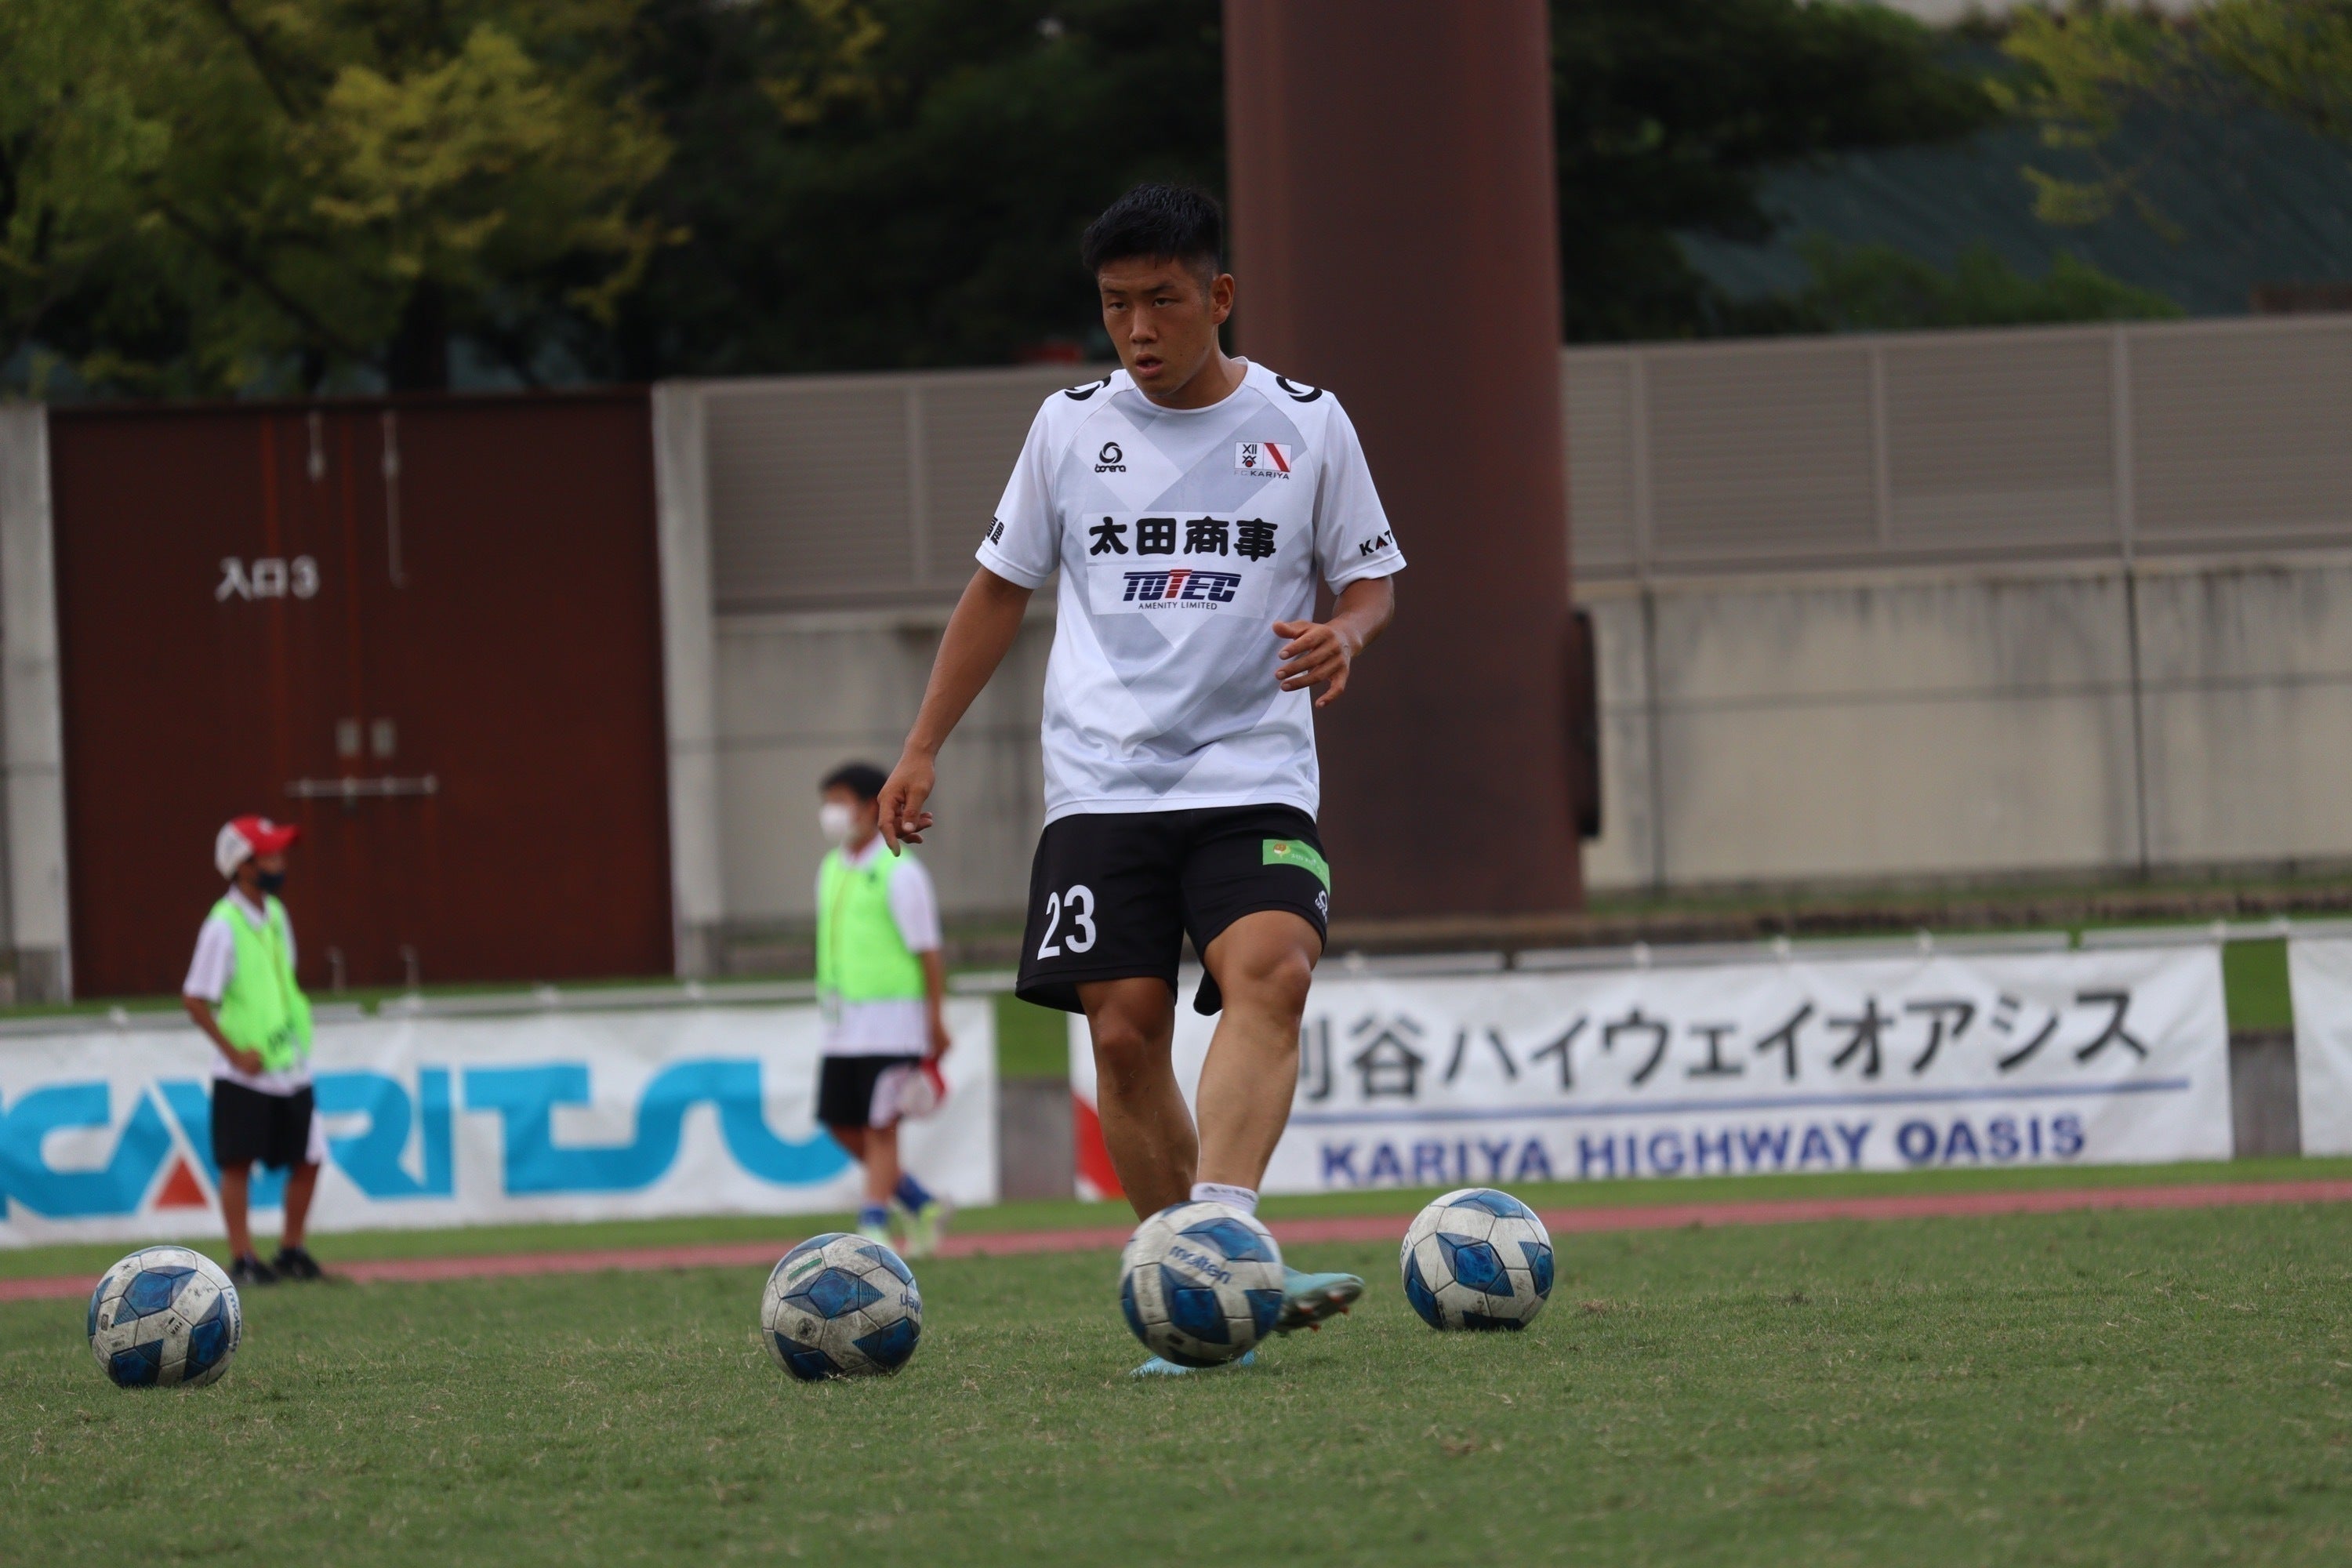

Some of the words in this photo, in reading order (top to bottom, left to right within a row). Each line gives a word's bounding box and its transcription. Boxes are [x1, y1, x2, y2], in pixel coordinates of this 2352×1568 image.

[1250, 470, 1290, 480] KARIYA
[1088, 516, 1279, 562] 太田商事
[214, 554, 320, 602] 入口3
[1123, 568, 1242, 603] TOTEC
[1181, 601, 1218, 610] LIMITED
[1036, 884, 1097, 960] 23
[1321, 1137, 1554, 1185] KARIYA
[1577, 1121, 1874, 1179] HIGHWAY
[1896, 1113, 2085, 1165] OASIS
[1168, 1245, 1232, 1284] molten
